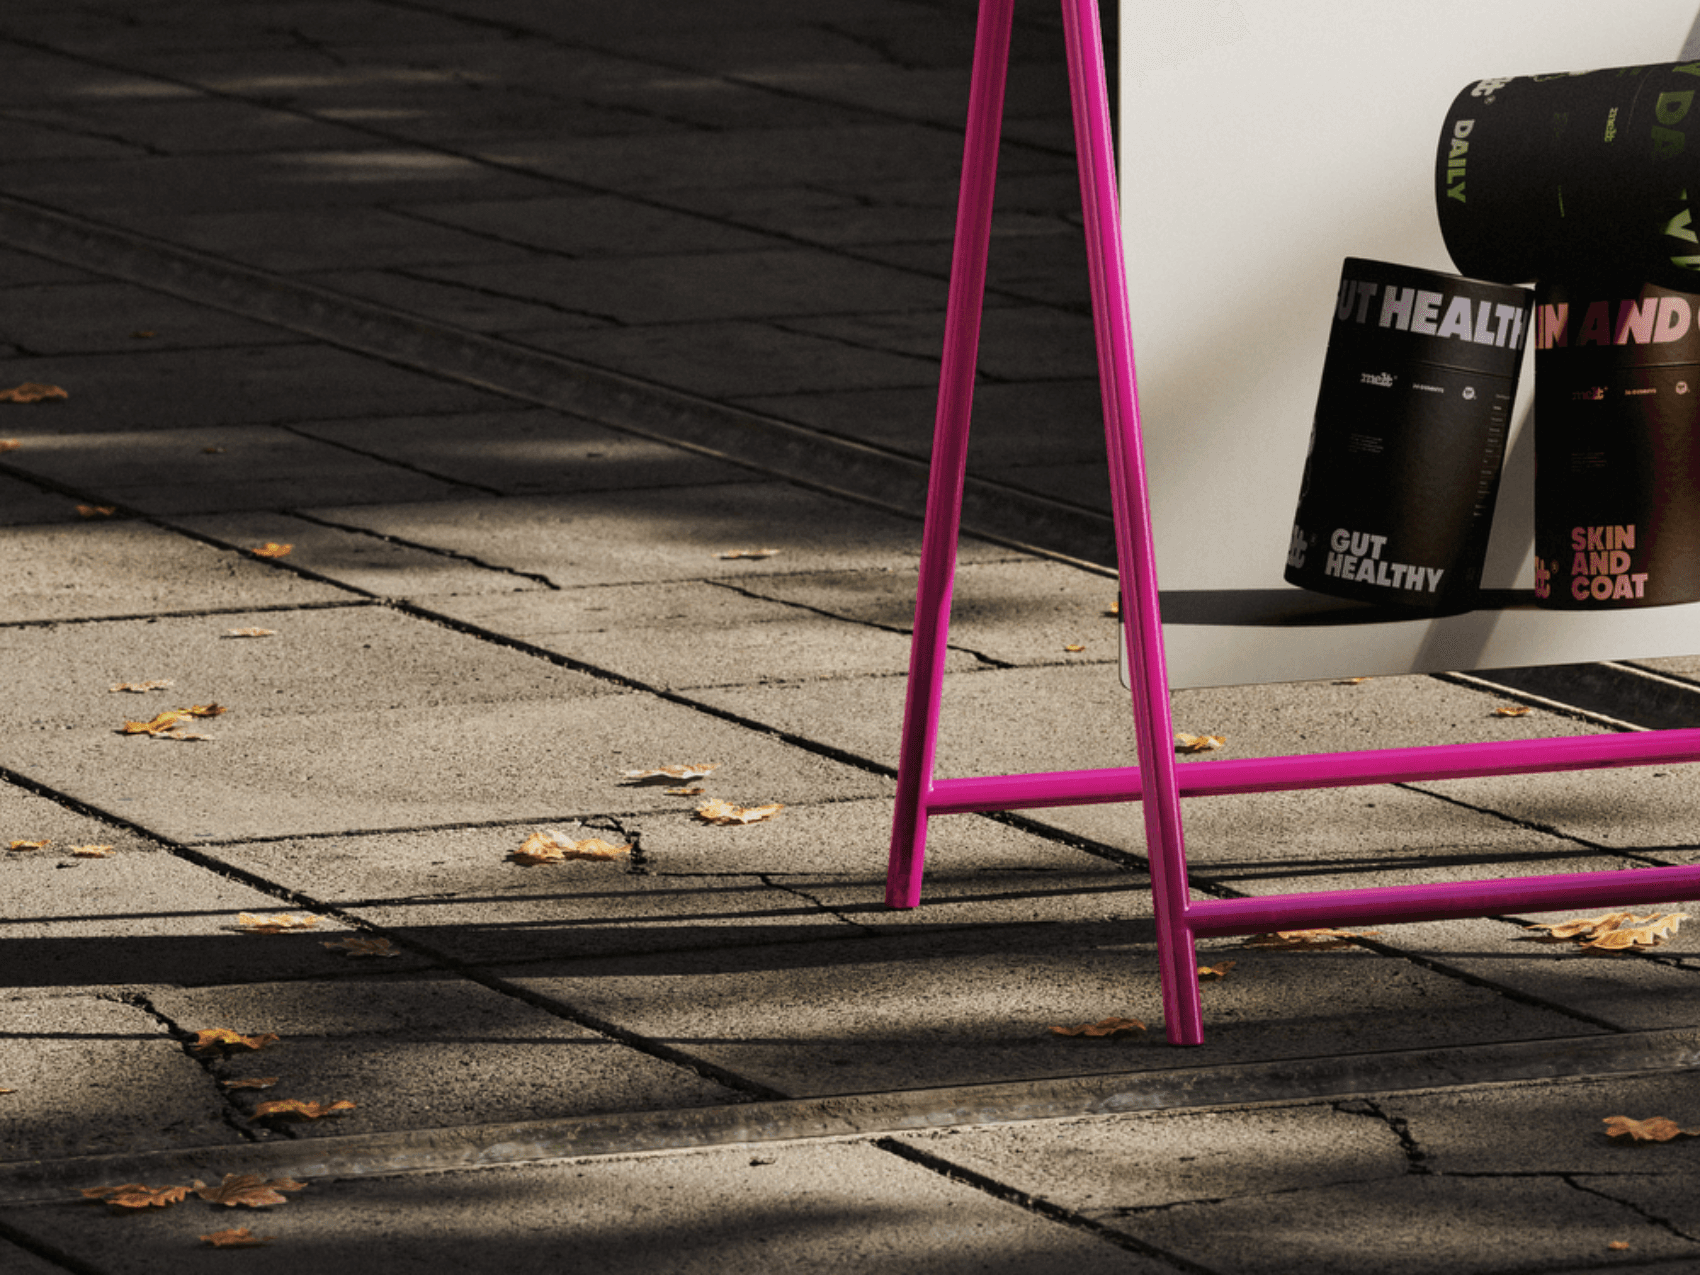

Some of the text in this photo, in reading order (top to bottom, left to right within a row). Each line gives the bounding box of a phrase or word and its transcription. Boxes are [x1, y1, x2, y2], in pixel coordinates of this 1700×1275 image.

[1446, 118, 1475, 204] DAILY
[1575, 296, 1692, 346] AND
[1330, 527, 1388, 561] GUT
[1570, 524, 1637, 552] SKIN
[1324, 551, 1445, 594] HEALTHY
[1570, 549, 1632, 576] AND
[1570, 572, 1649, 601] COAT
